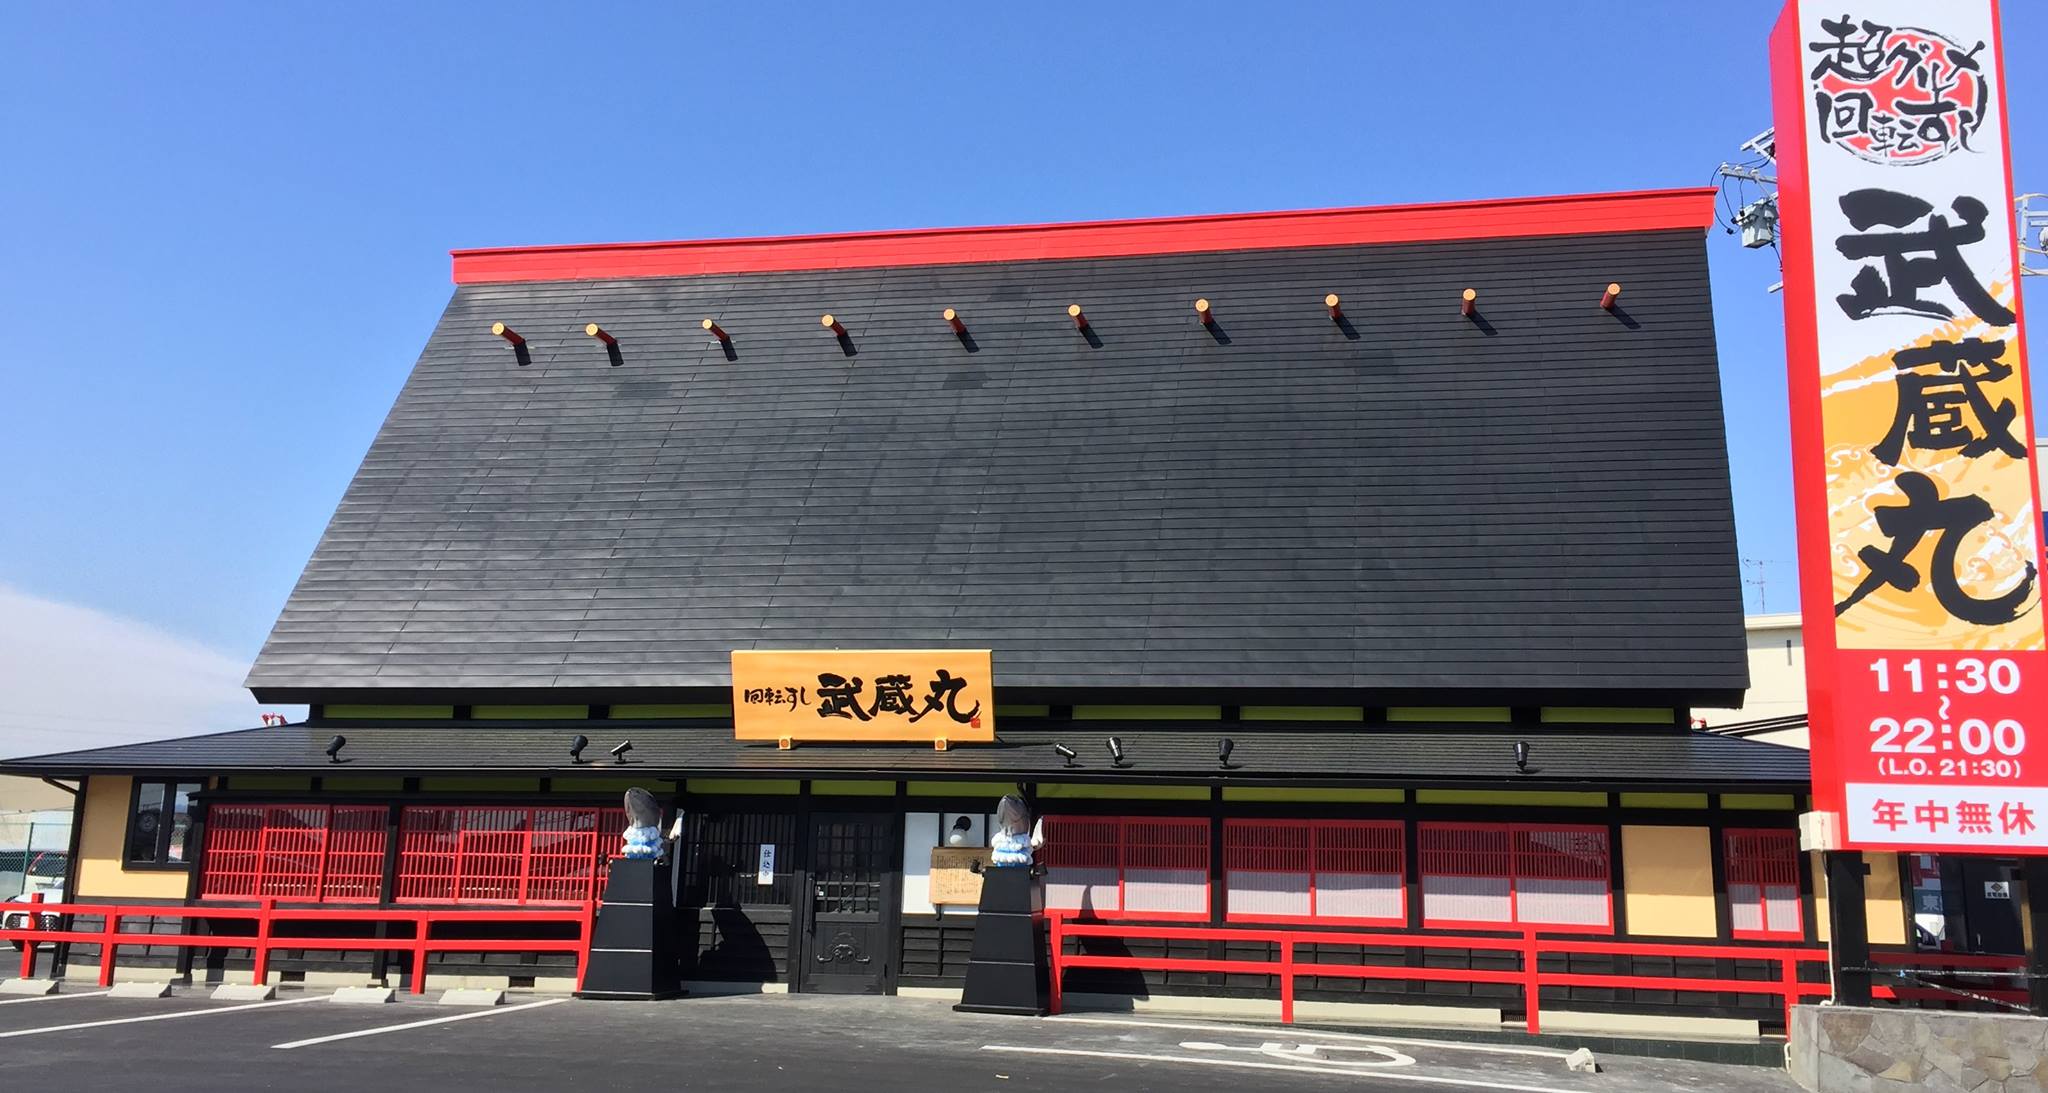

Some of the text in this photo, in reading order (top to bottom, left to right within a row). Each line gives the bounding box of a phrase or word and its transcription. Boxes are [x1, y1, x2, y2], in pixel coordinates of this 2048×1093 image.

[1809, 14, 1985, 92] 超グルメ
[1815, 92, 1985, 157] 回転すし
[1835, 188, 2042, 626] 武蔵丸
[744, 669, 982, 723] 回転すし 武蔵丸
[1870, 658, 2020, 694] 11:30
[1869, 717, 2025, 755] 22:00
[1872, 799, 2036, 835] 年中無休
